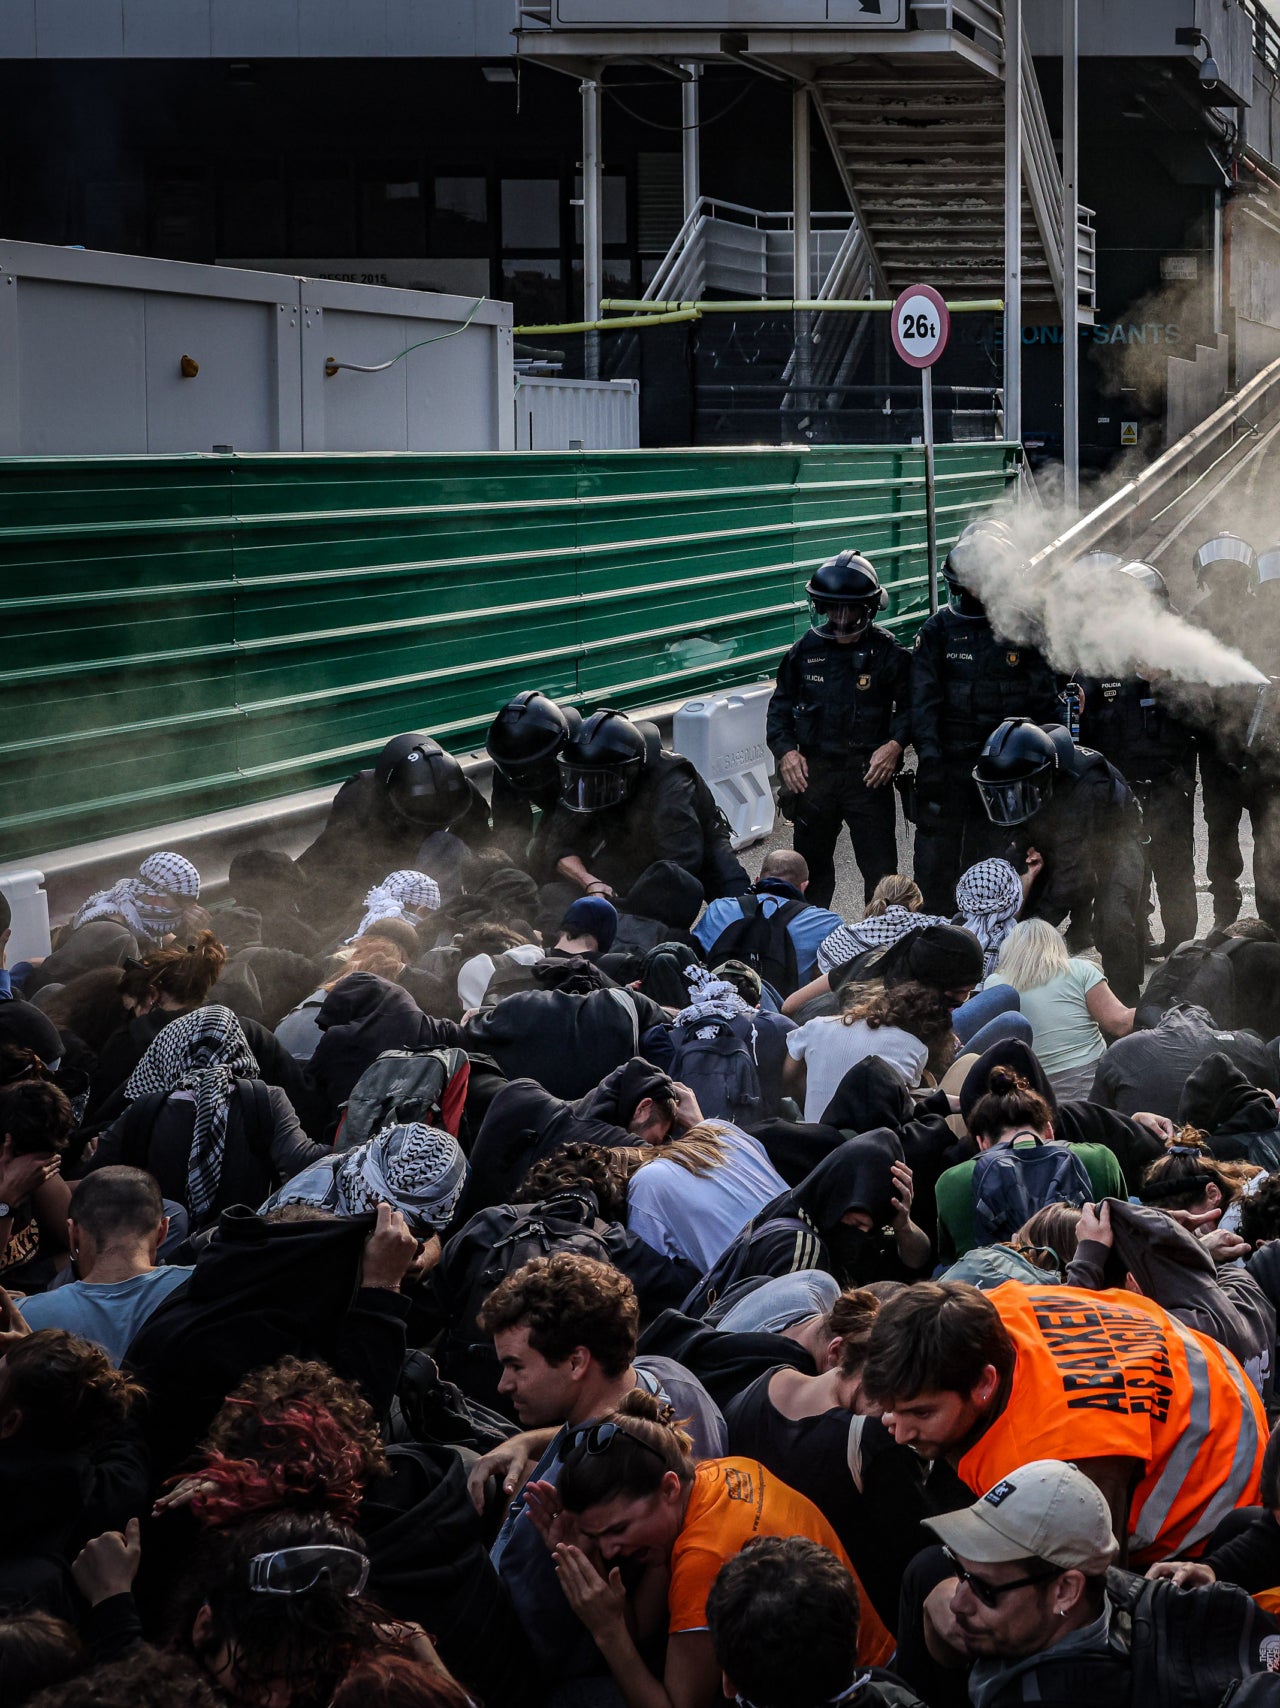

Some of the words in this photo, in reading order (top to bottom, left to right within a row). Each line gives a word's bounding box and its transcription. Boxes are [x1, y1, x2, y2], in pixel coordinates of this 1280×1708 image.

[361, 274, 387, 284] 2015
[902, 314, 936, 339] 26t
[1092, 323, 1181, 345] SANTS
[946, 652, 973, 661] POLICIA
[1028, 1295, 1130, 1415] ABAIXEM
